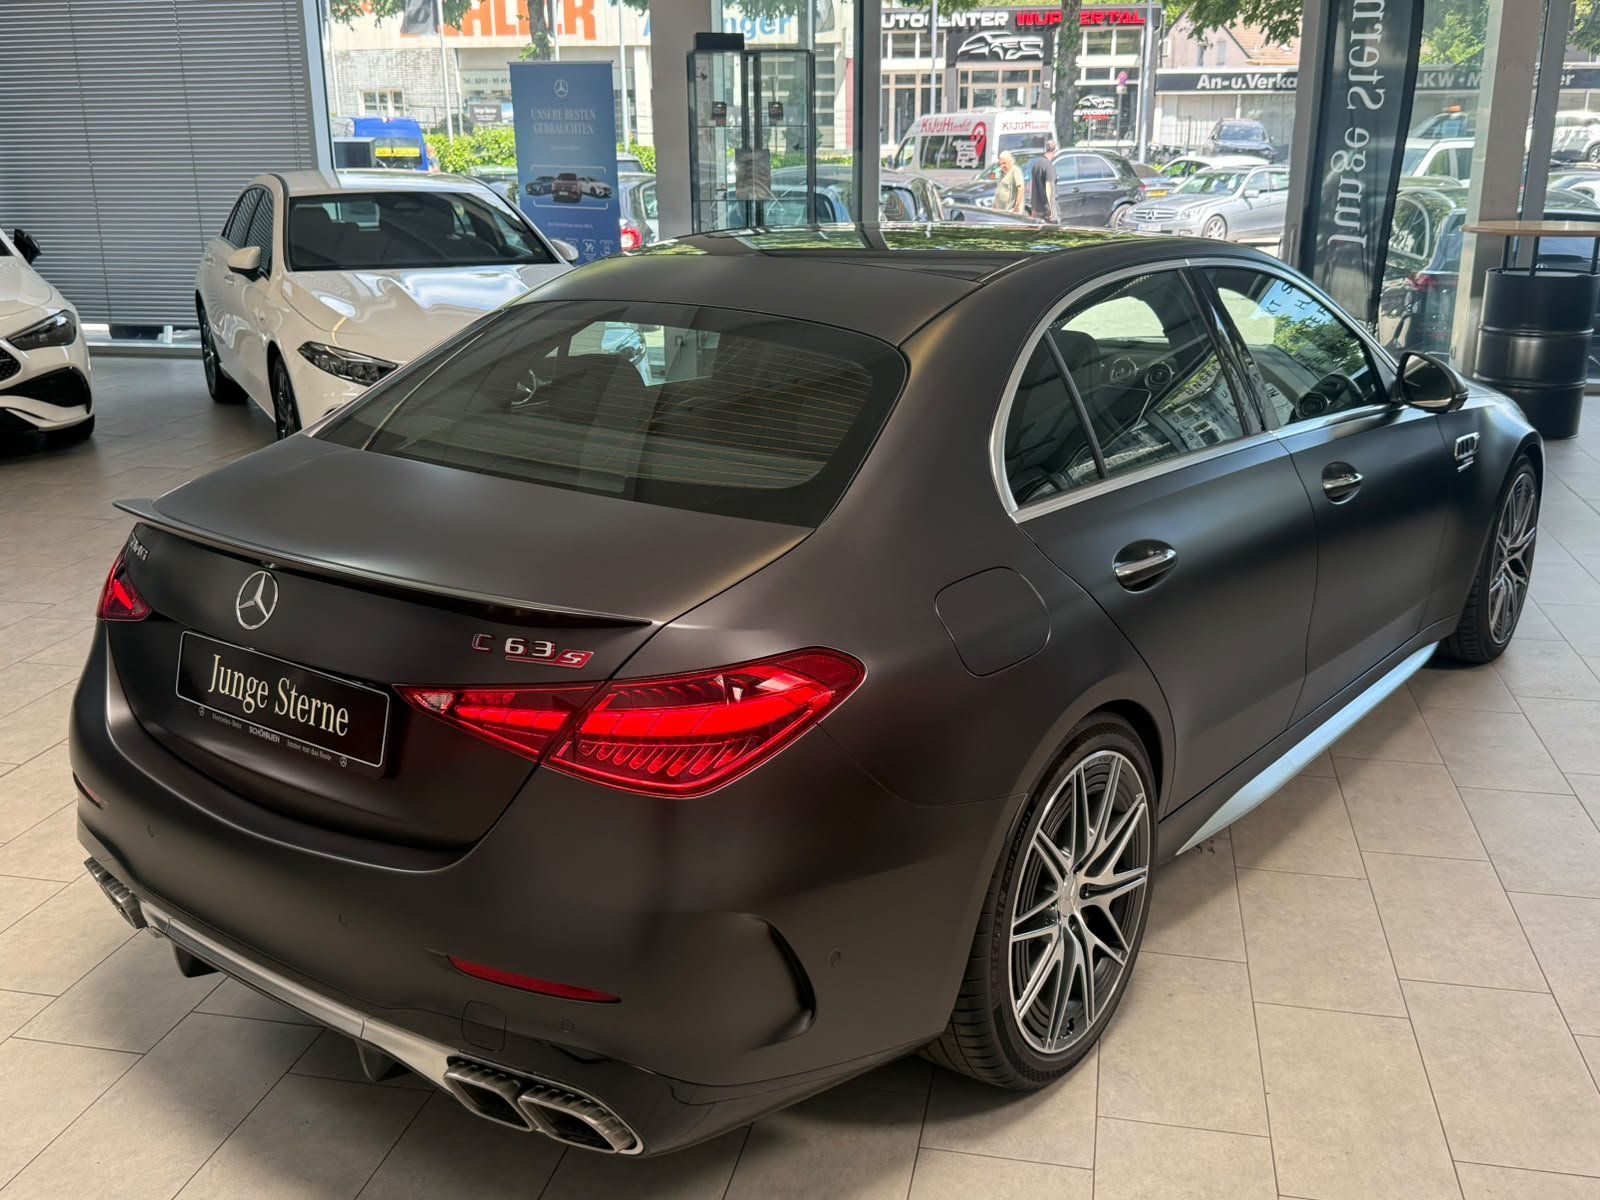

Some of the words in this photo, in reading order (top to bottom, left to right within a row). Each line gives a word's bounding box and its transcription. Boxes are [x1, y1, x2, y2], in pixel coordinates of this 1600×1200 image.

[1016, 10, 1146, 26] WUPERTAL
[472, 633, 494, 651] C
[504, 637, 556, 657] 63
[208, 653, 269, 714] Junge
[274, 677, 350, 737] Sterne
